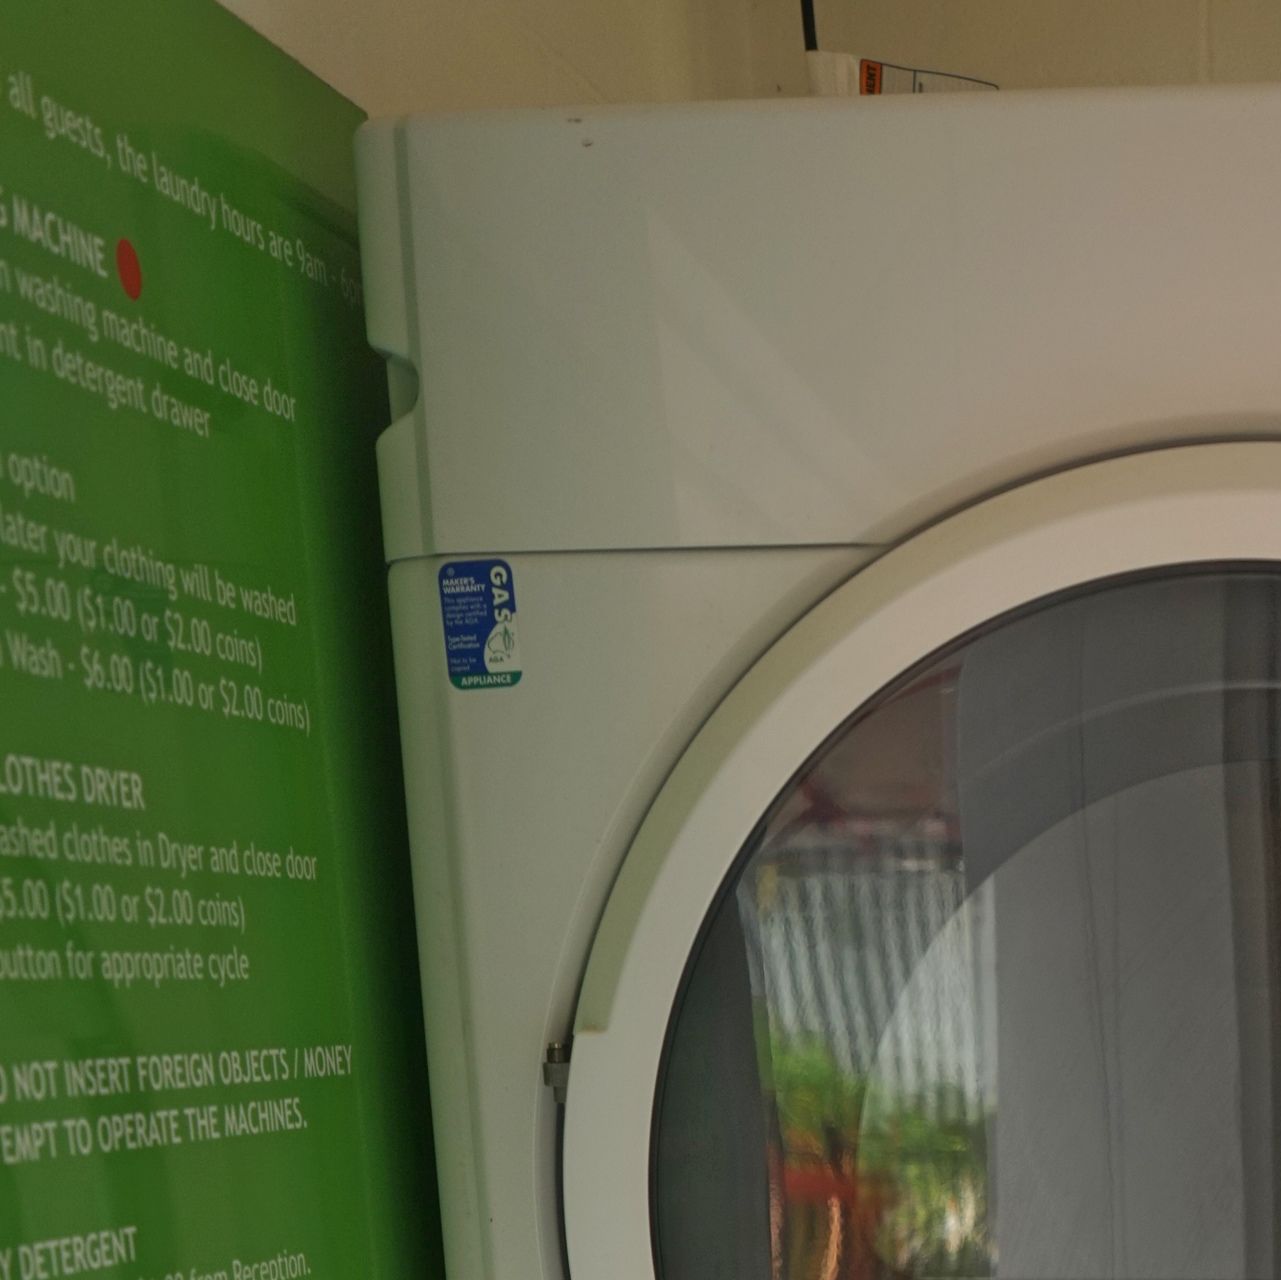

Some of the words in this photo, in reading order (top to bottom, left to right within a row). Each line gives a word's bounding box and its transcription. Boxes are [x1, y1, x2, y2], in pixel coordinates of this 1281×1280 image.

[8, 70, 36, 119] all
[41, 95, 112, 169] guests,
[116, 132, 148, 183] the
[151, 150, 217, 231] laundry
[221, 192, 265, 251] hours
[269, 231, 293, 267] are
[296, 238, 328, 286] 9am
[12, 194, 108, 278] MACHINE
[15, 266, 98, 343] washing
[102, 309, 179, 370] machine
[183, 347, 215, 387] and
[218, 357, 259, 406] close
[263, 378, 296, 423] door
[25, 323, 47, 371] in
[52, 338, 147, 414] detergent
[151, 381, 210, 439] drawer
[8, 452, 76, 503] option
[53, 529, 97, 570] your
[102, 537, 177, 601] clothing
[180, 564, 212, 602] will
[215, 570, 236, 609] be
[239, 585, 297, 627] washed
[489, 565, 513, 624] GAS
[12, 567, 71, 622] $5.00
[76, 584, 137, 638] ($1.00
[141, 612, 159, 643] or
[164, 607, 212, 657] $2.00
[215, 628, 263, 676] coins)
[4, 627, 63, 680] Wash
[79, 645, 133, 696] $6.00
[139, 660, 194, 708] ($1.00
[199, 682, 215, 712] or
[219, 676, 264, 722] $2.00
[267, 694, 311, 738] coins)
[461, 674, 511, 687] APPLIANCE
[80, 763, 147, 811] DRYER
[62, 821, 133, 867] clothes
[136, 829, 155, 868] in
[158, 831, 204, 880] Dryer
[210, 840, 239, 875] and
[243, 842, 282, 878] close
[285, 847, 318, 881] door
[55, 878, 116, 929] ($1.00
[121, 892, 141, 923] or
[145, 884, 194, 929] $2.00
[198, 892, 246, 935] coins)
[65, 939, 97, 979] for
[101, 944, 204, 989] appropriate
[208, 946, 250, 988] cycle
[12, 1060, 59, 1102] NOT
[63, 1056, 132, 1098] INSERT
[136, 1052, 217, 1093] FOREIGN
[218, 1047, 290, 1086] OBJECTS
[303, 1044, 353, 1079] MONEY
[63, 1118, 93, 1156] TO
[97, 1109, 182, 1153] OPERATE
[184, 1105, 221, 1141] THE
[224, 1097, 308, 1138] MACHINES.
